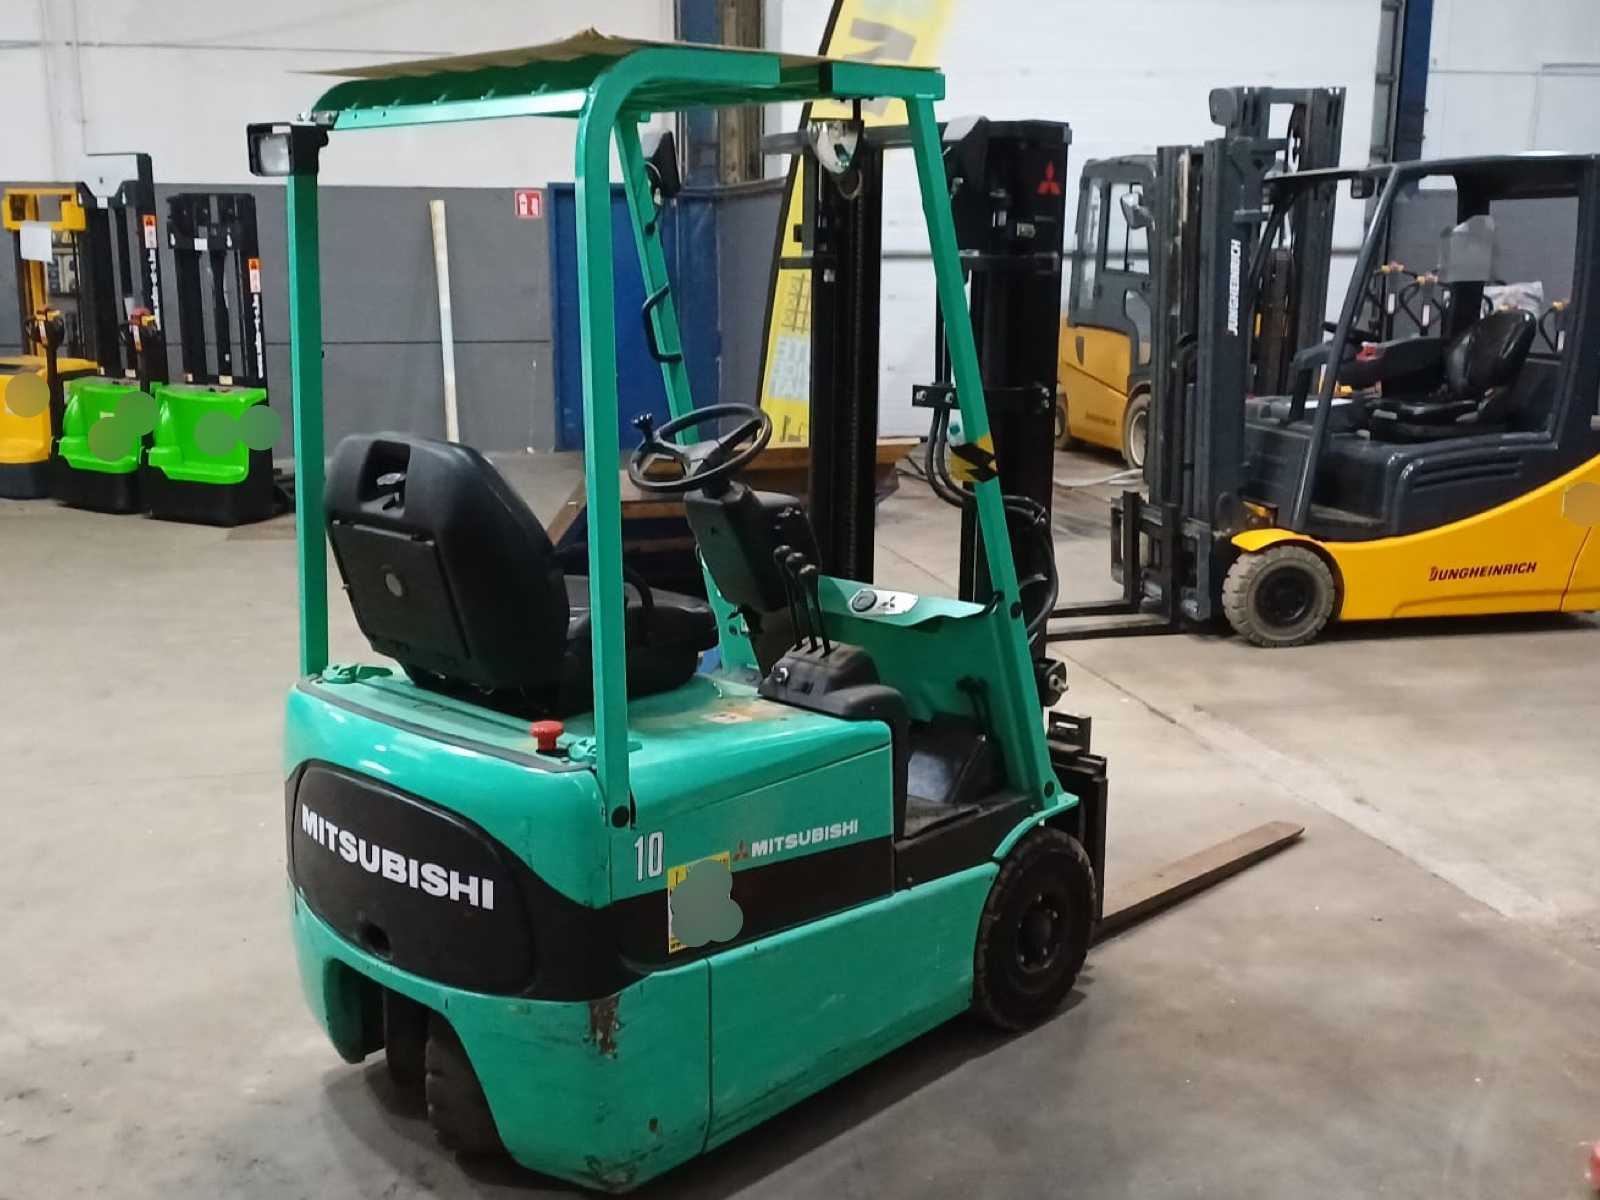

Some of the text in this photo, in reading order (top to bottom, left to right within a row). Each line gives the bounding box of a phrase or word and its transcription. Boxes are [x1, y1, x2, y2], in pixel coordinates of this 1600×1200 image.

[1428, 561, 1538, 582] JUNGHEINRICH
[302, 803, 494, 910] MITSUBISHI
[634, 831, 664, 882] 10
[751, 818, 858, 858] MITSUBISHI
